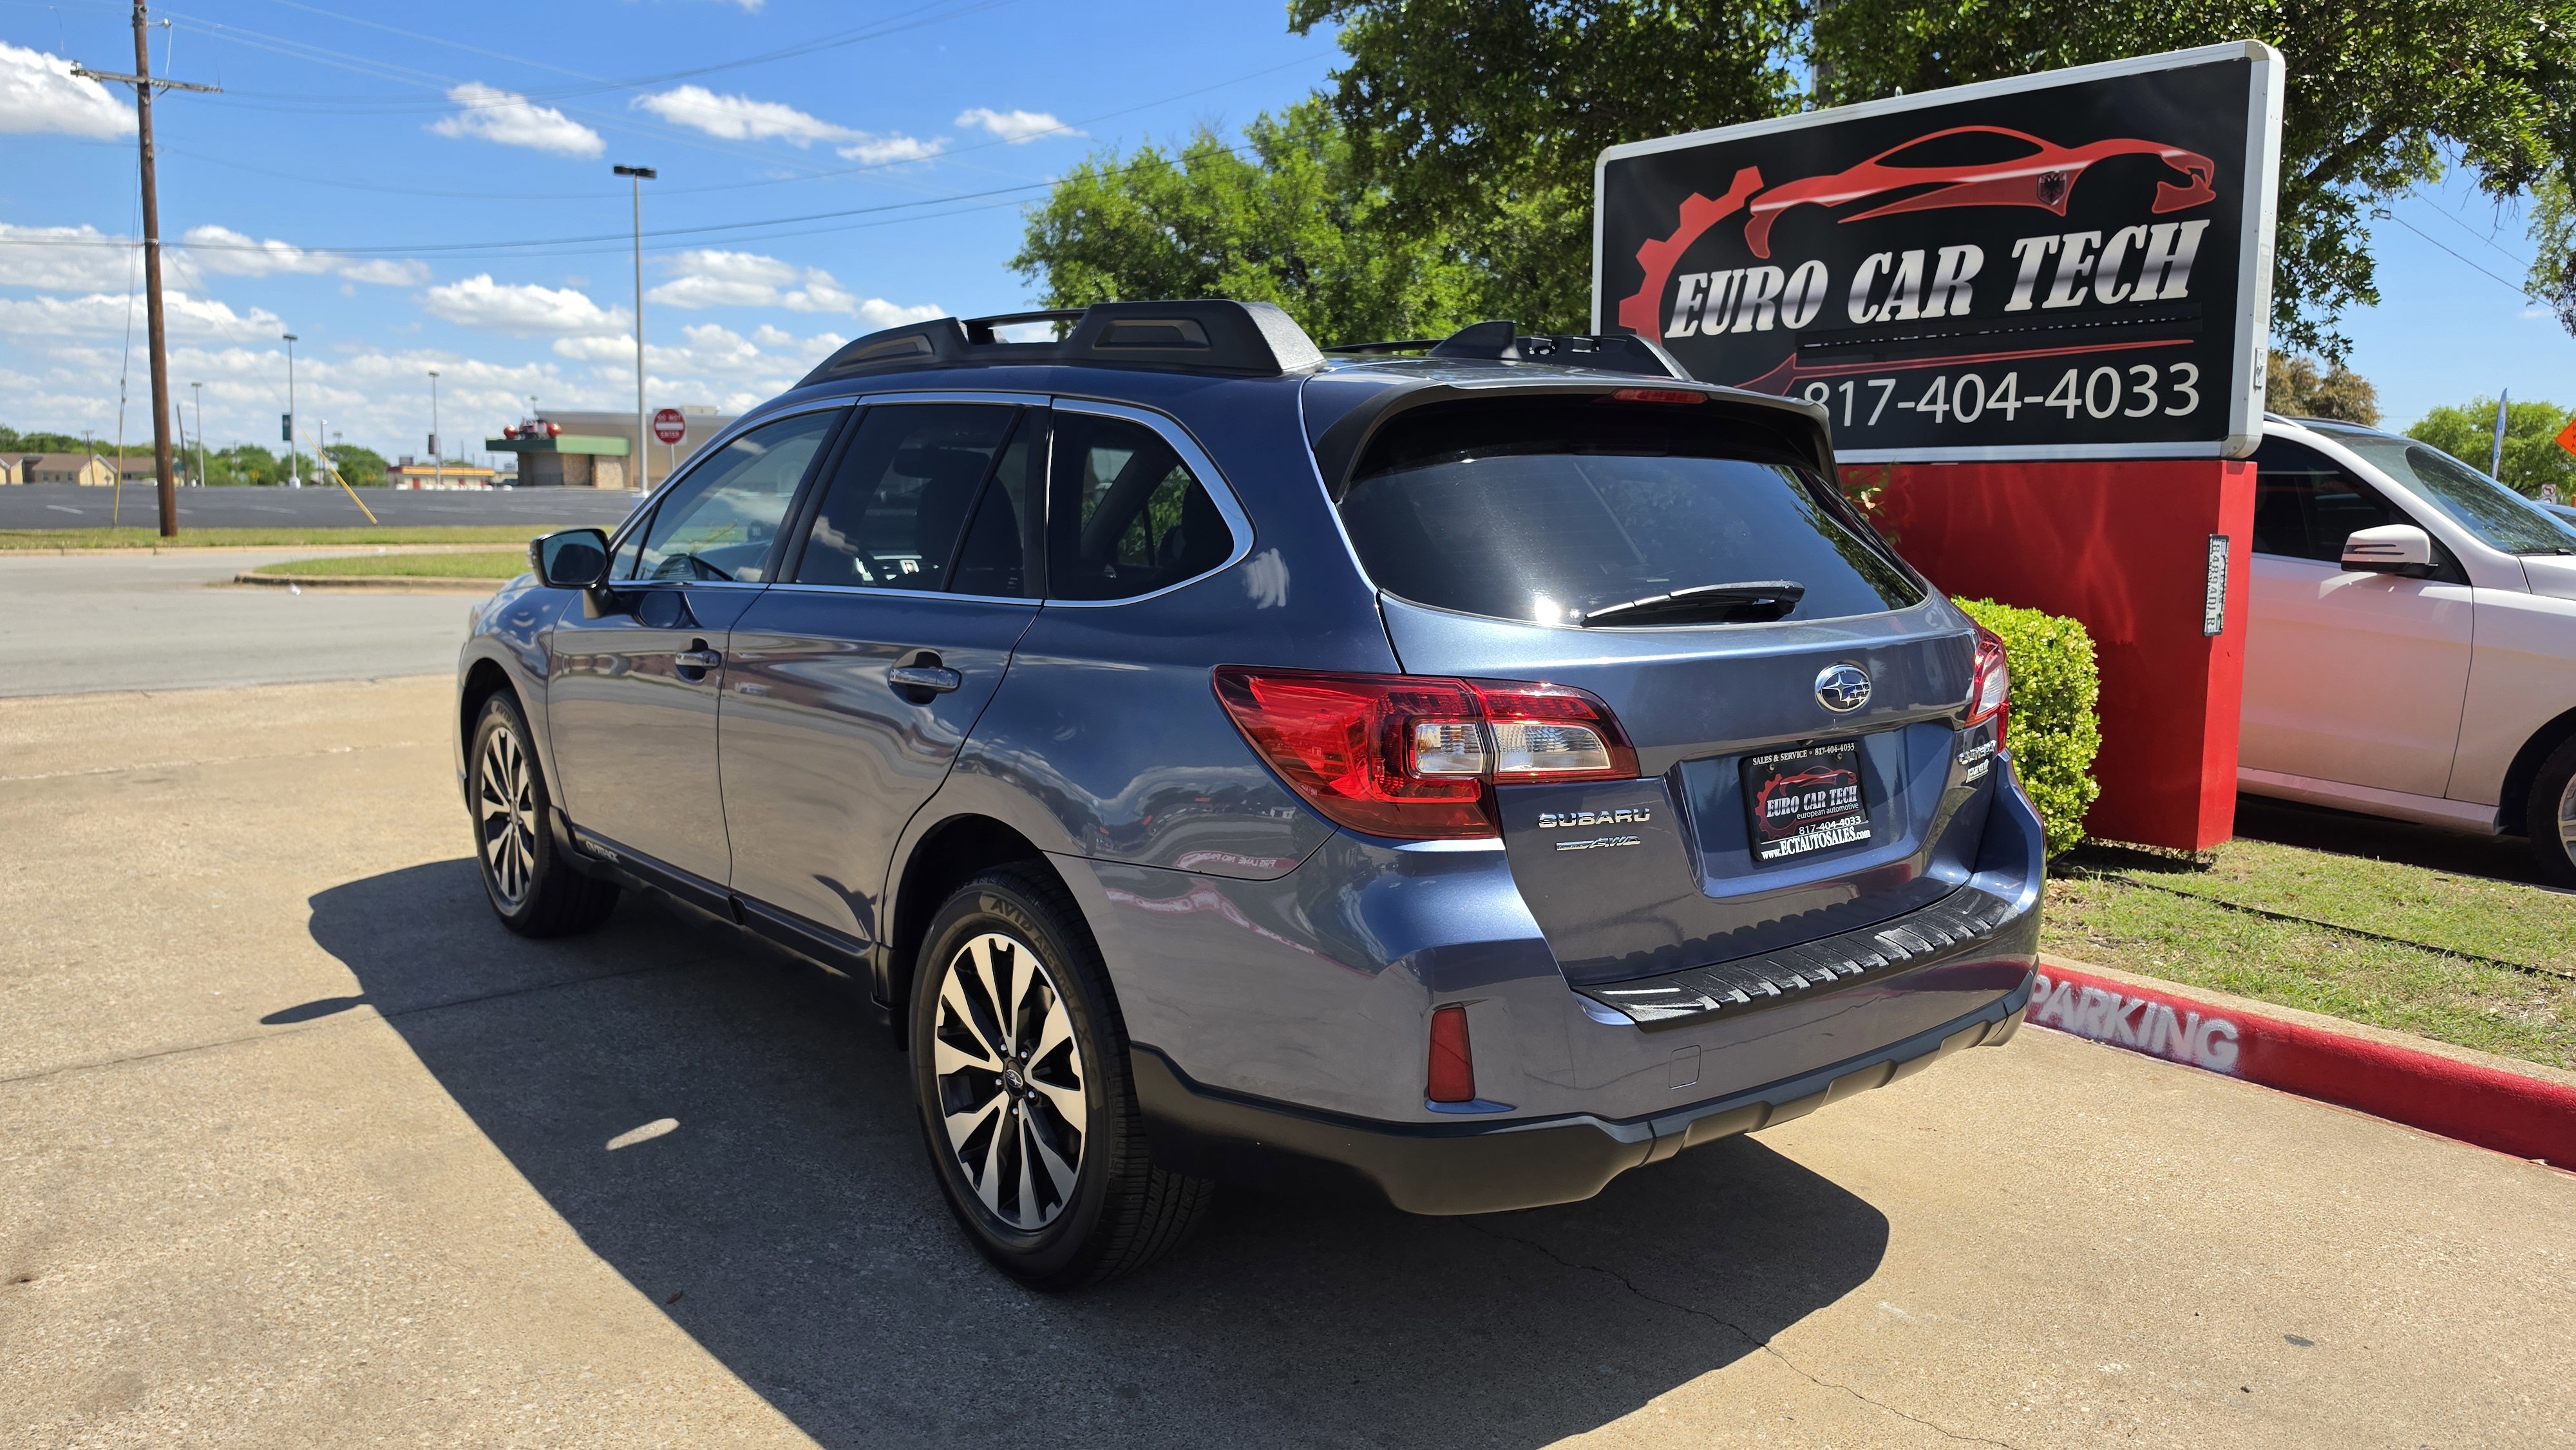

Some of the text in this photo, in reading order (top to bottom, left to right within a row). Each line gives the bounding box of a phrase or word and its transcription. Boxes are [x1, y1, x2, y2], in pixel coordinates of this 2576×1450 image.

[1665, 259, 1828, 338] EURO
[1848, 244, 1984, 324] CAR
[2004, 219, 2210, 312] TECH
[1804, 362, 2200, 427] 817-404-4033
[1752, 754, 1772, 766] SALES
[1780, 750, 1808, 762] SERVICE
[1815, 742, 1855, 756] 817-404-4033
[1539, 807, 1651, 829] SUBARU
[1766, 785, 1858, 818] EURO CAR TECH
[1797, 802, 1859, 820] european automotive
[1799, 815, 1862, 835] 817-404-4033
[1589, 835, 1641, 849] AWD
[1761, 825, 1871, 860] www.ECTAUTOSALES.com
[990, 899, 1033, 932] AVID
[1034, 936, 1077, 998] Ascend
[2031, 974, 2239, 1072] PARKING
